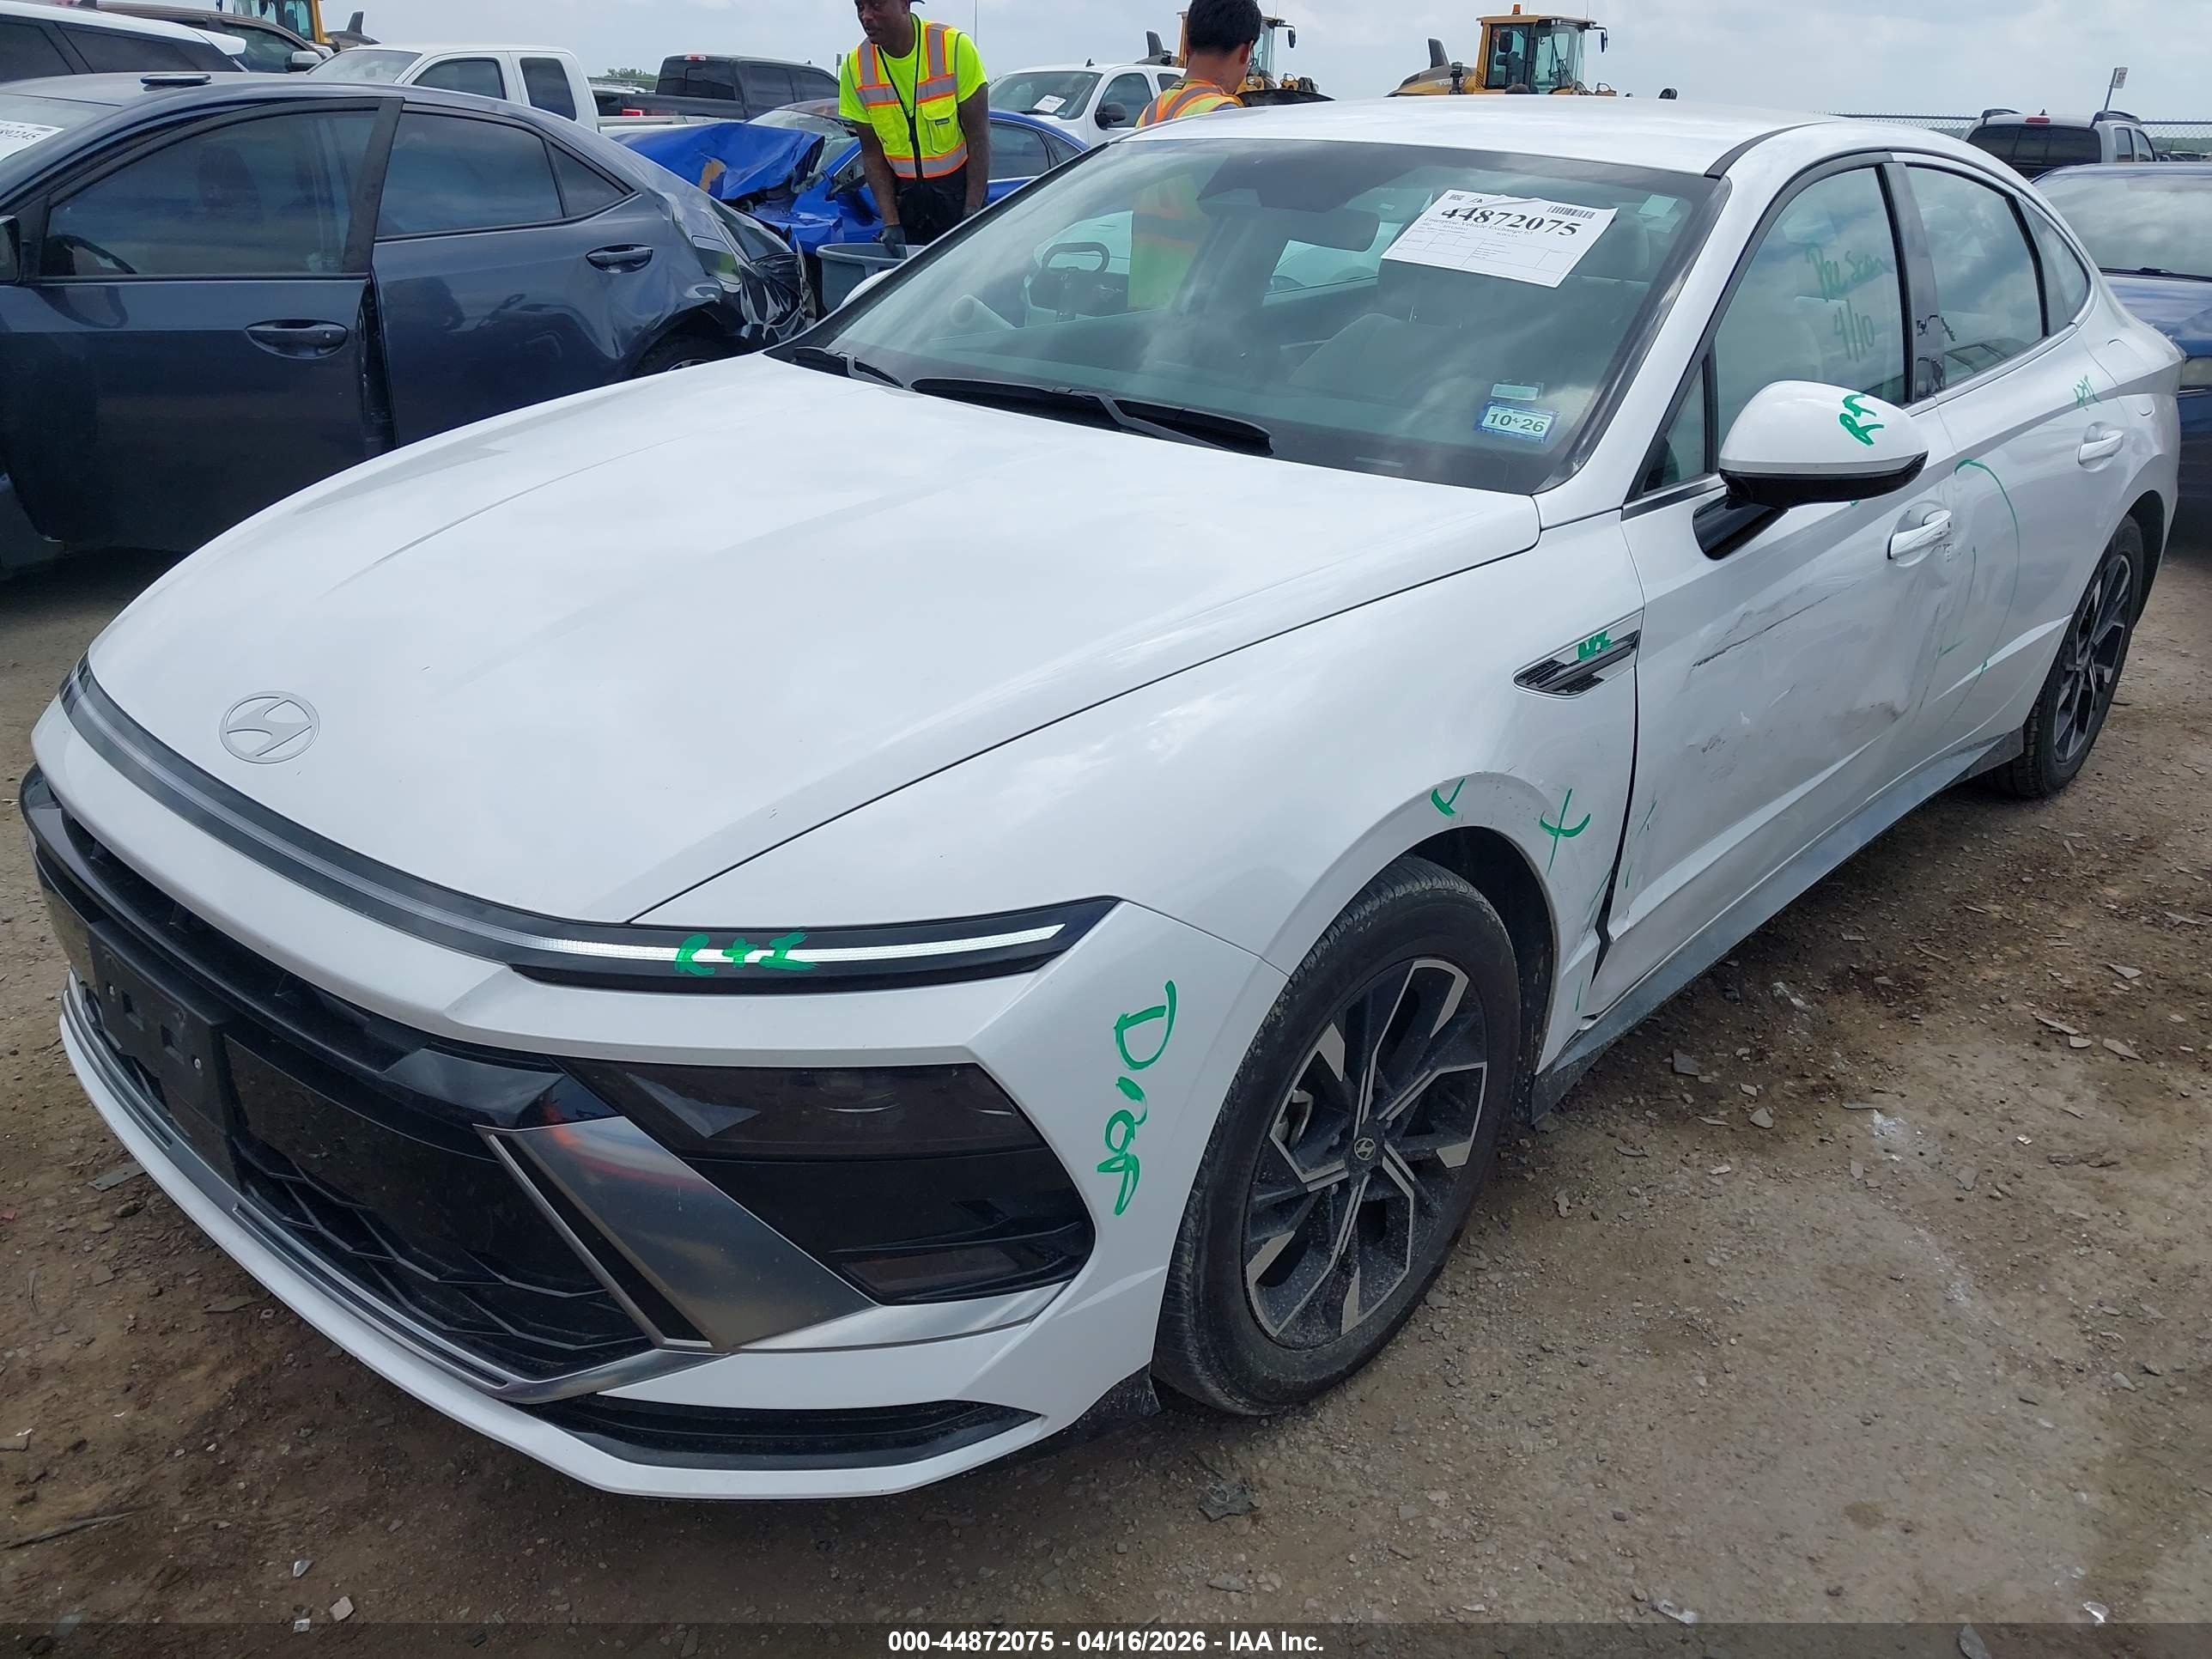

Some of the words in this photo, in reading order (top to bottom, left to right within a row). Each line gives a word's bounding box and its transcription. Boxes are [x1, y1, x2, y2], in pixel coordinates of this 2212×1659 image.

[1441, 207, 1582, 236] 44872075
[1490, 413, 1512, 426] 10
[1519, 418, 1546, 432] 26
